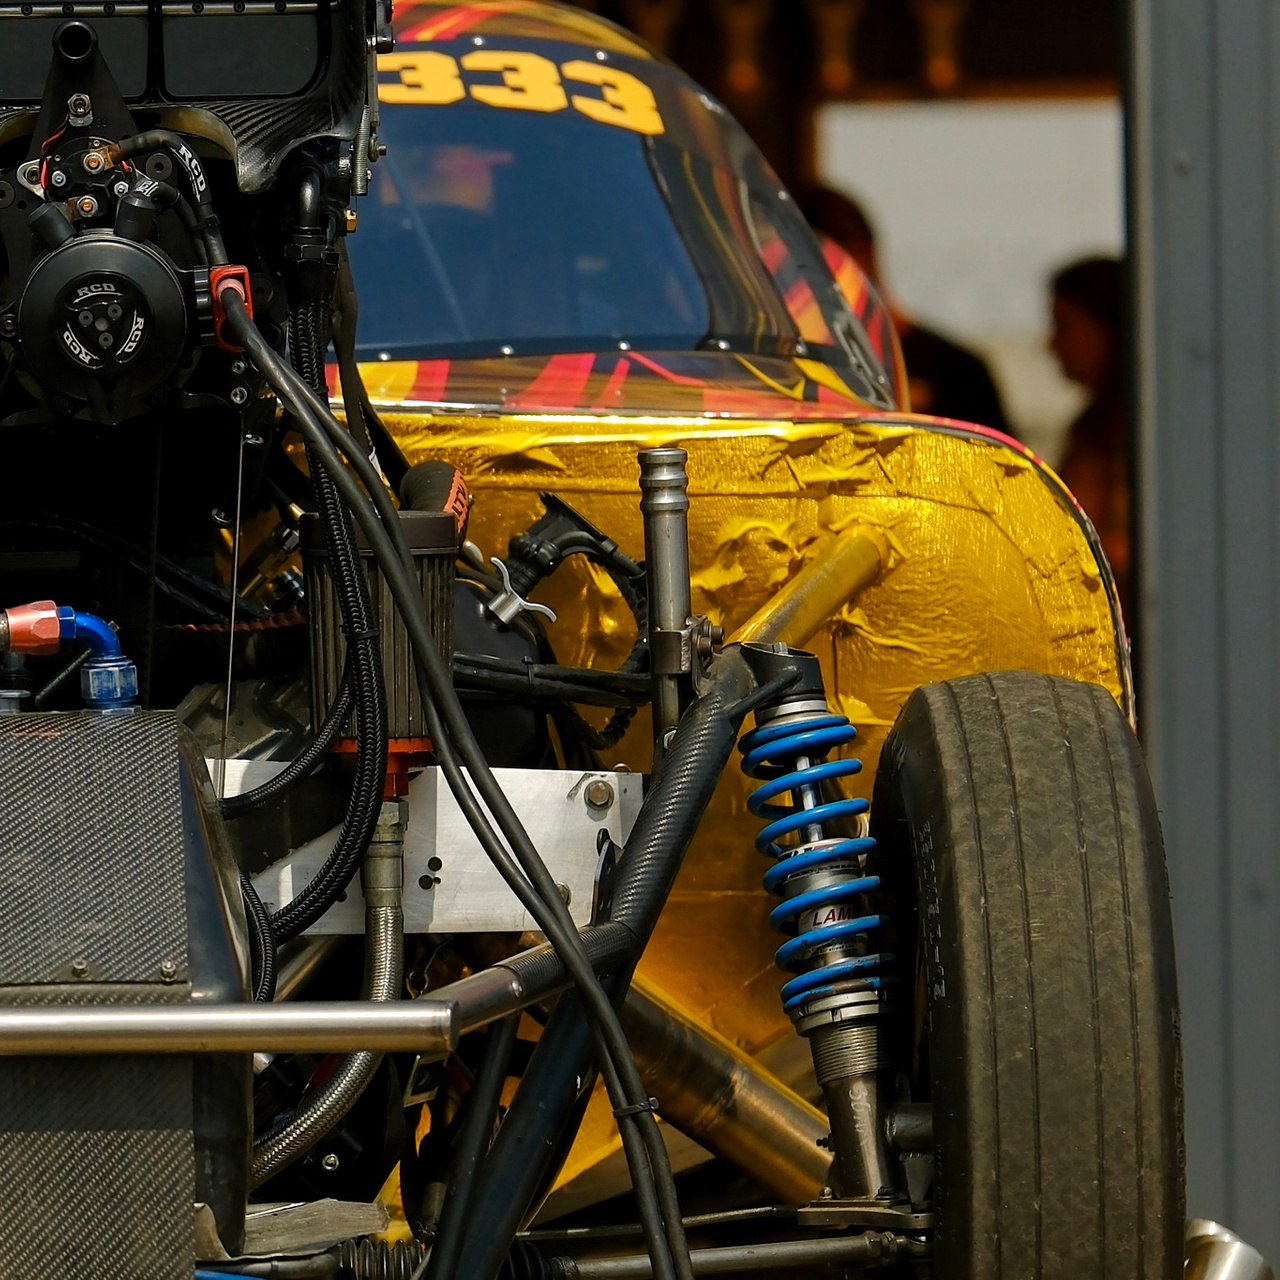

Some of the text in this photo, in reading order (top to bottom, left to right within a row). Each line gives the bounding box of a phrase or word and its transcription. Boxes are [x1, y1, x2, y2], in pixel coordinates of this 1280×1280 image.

[376, 49, 666, 136] 333
[177, 142, 208, 194] RCD
[75, 282, 117, 298] RCD
[62, 329, 93, 365] RCD
[123, 315, 146, 354] RCD
[812, 907, 854, 927] LAM
